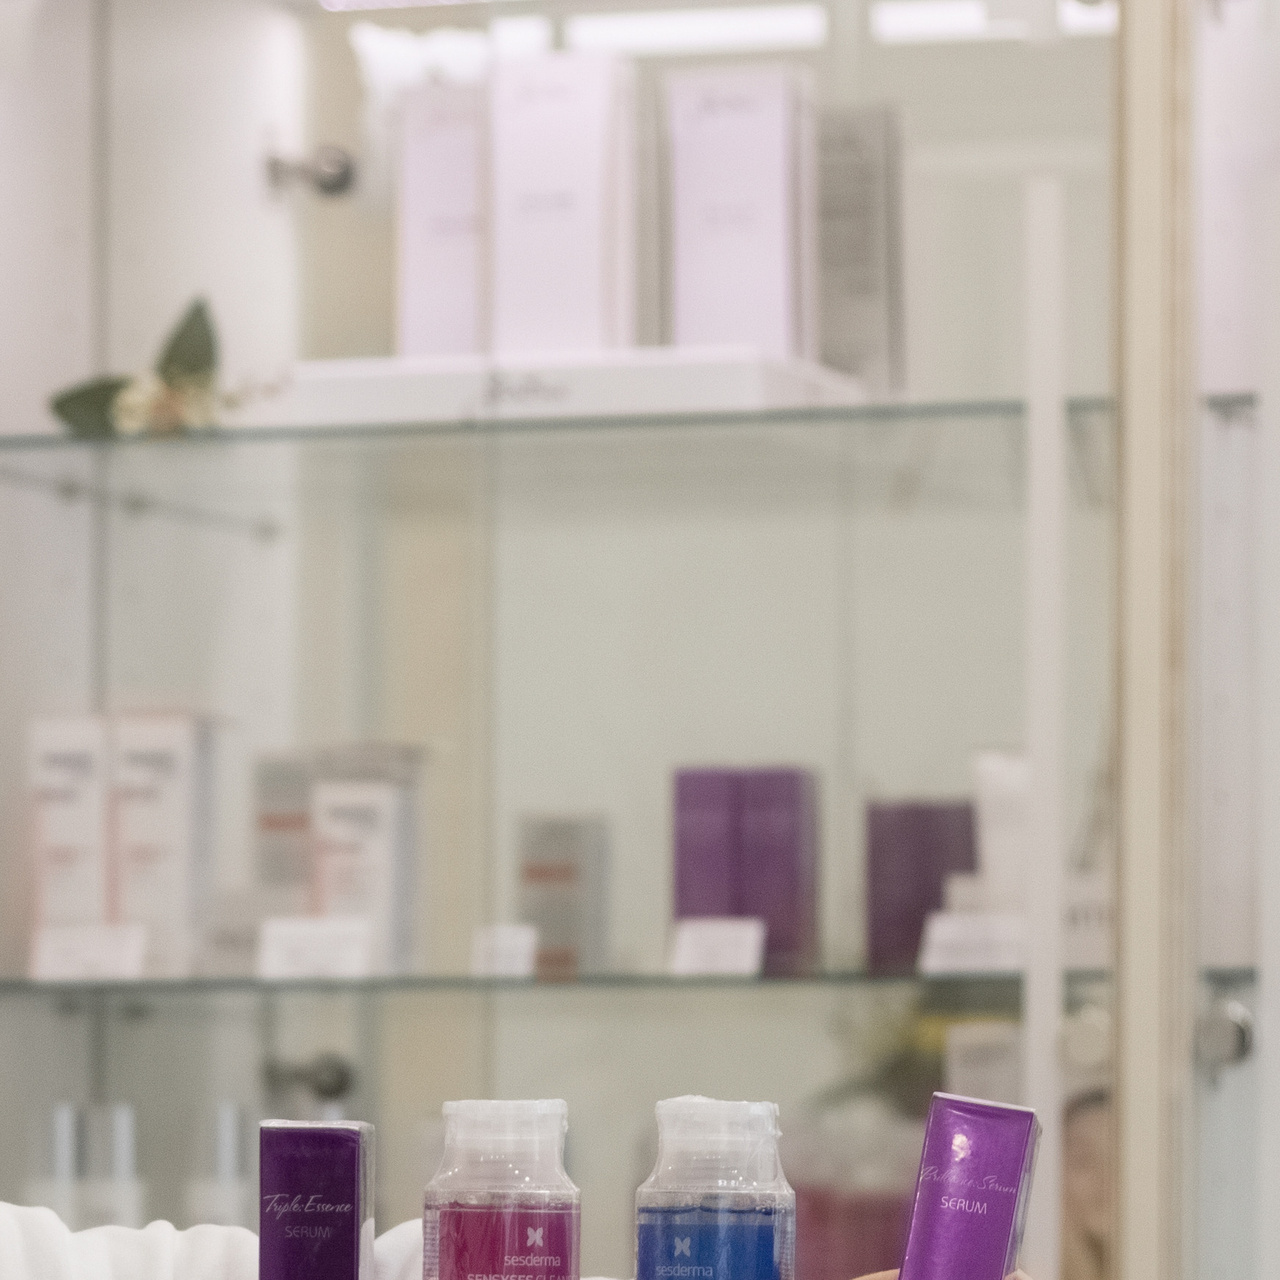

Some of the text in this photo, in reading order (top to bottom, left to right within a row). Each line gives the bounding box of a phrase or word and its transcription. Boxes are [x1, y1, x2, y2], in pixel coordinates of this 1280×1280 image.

[940, 1195, 988, 1214] SERUM
[285, 1225, 331, 1239] SERUM
[504, 1253, 561, 1267] sesderma
[655, 1263, 713, 1277] sesderma
